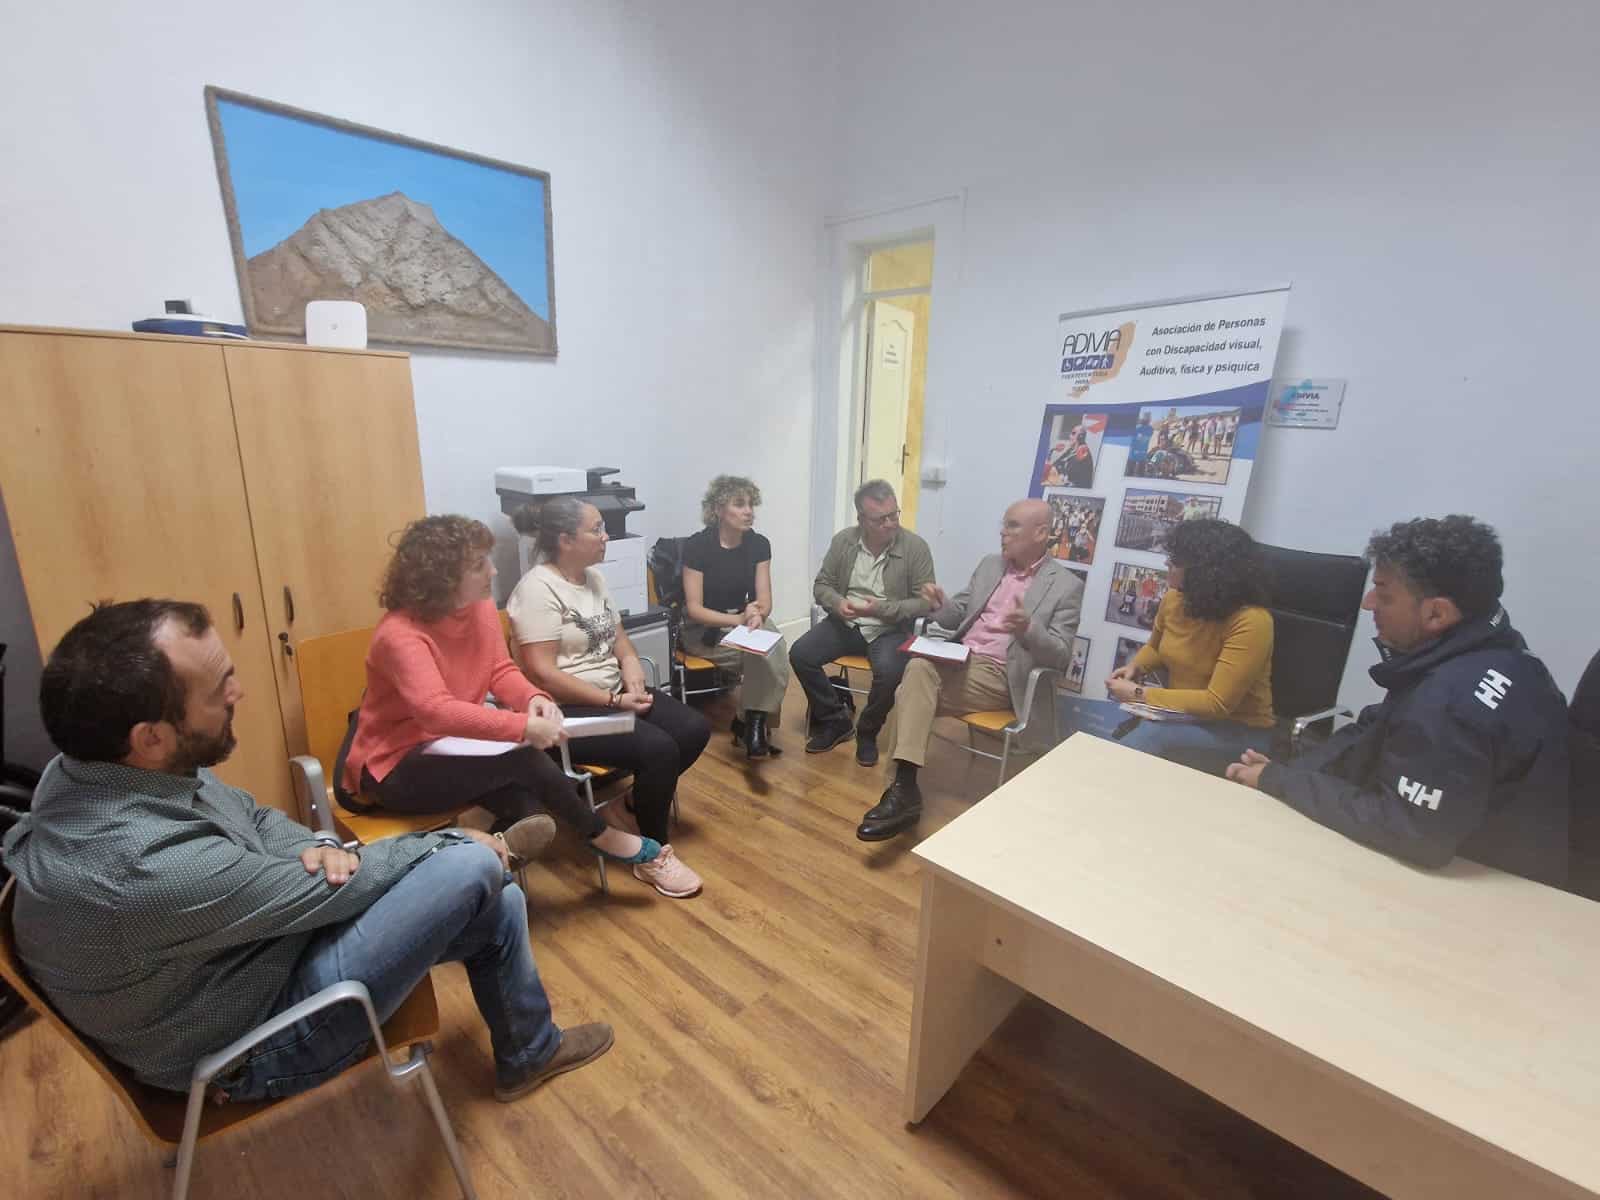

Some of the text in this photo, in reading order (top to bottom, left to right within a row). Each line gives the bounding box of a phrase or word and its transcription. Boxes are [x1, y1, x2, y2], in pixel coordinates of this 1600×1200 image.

[1203, 321, 1216, 332] de
[1218, 317, 1266, 331] Personas
[1062, 329, 1121, 356] ADIVIA
[1145, 338, 1262, 356] con Discapacidad visual,
[1139, 364, 1178, 376] Auditiva,
[1206, 364, 1214, 375] y
[1473, 668, 1513, 710] HH
[1397, 775, 1444, 811] HH
